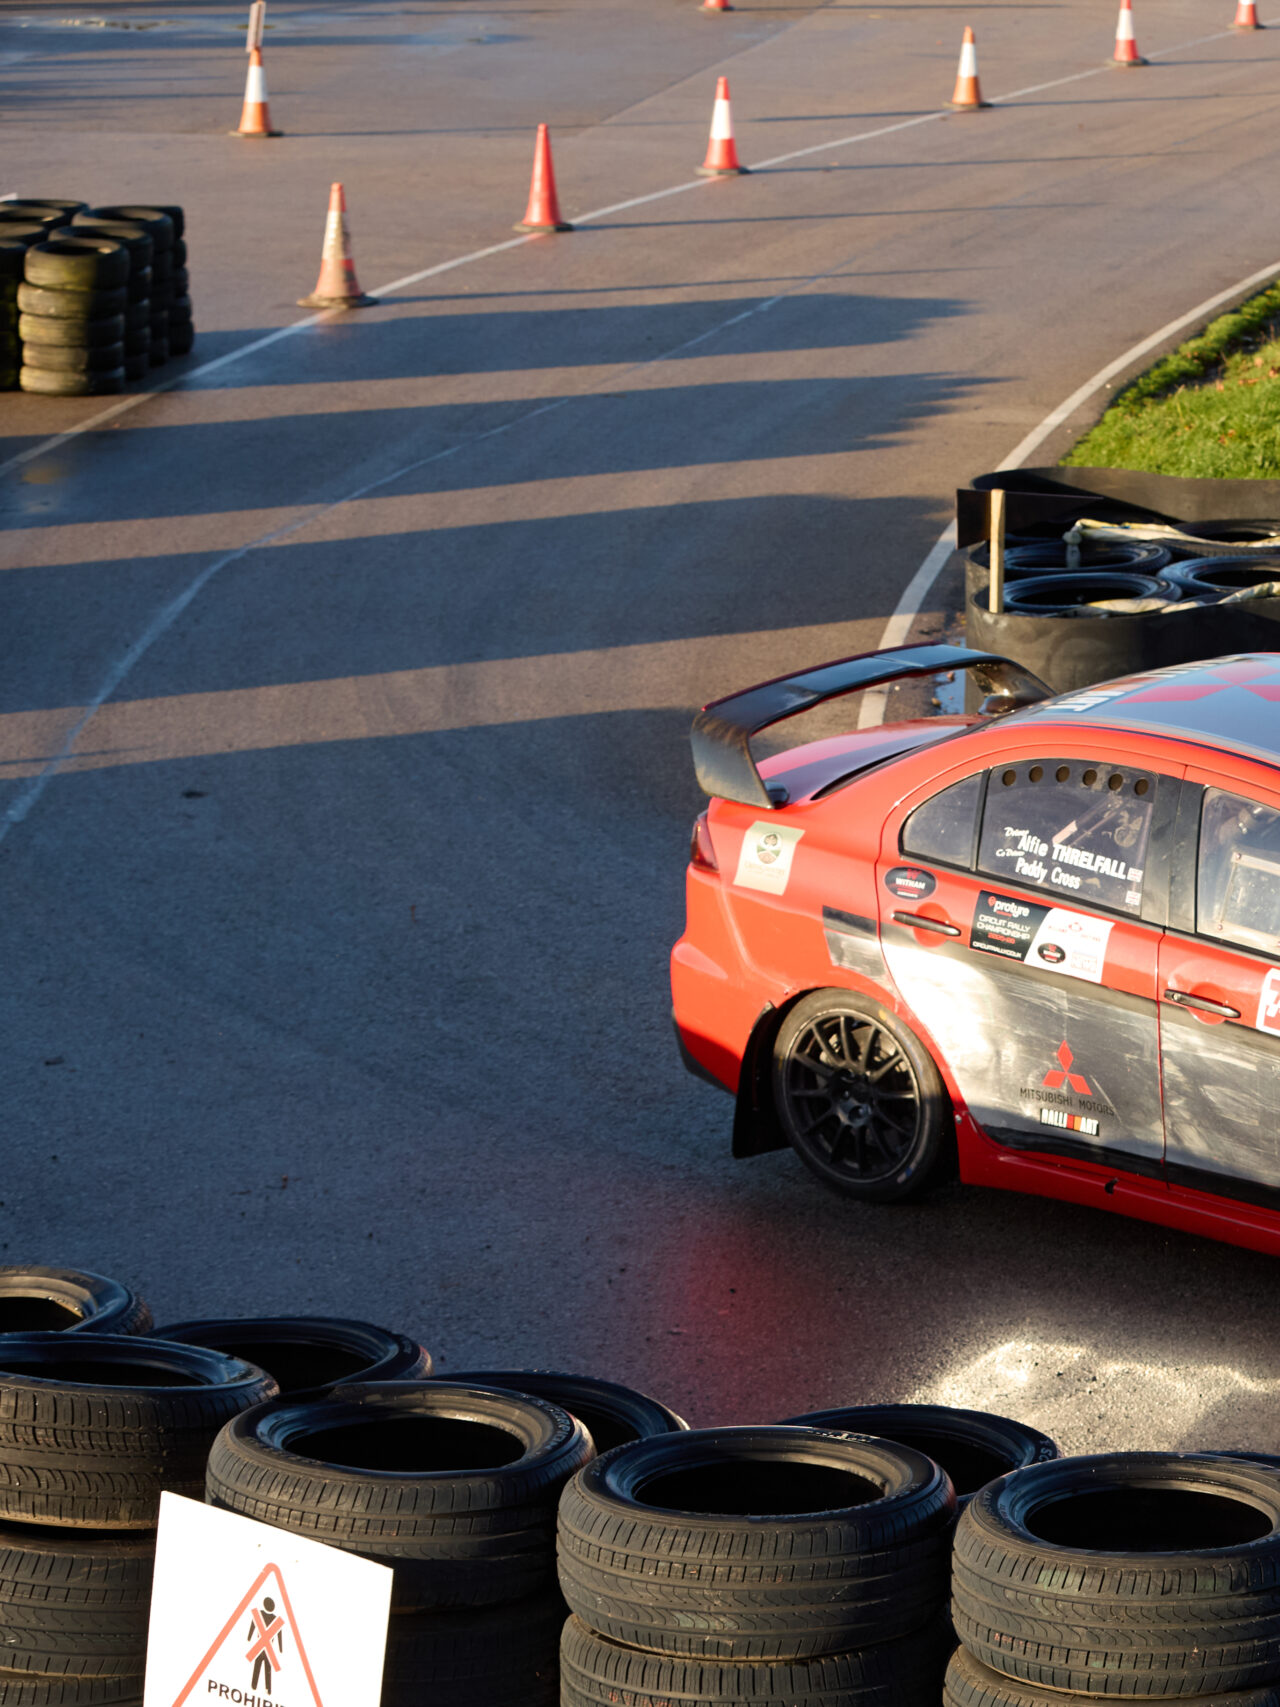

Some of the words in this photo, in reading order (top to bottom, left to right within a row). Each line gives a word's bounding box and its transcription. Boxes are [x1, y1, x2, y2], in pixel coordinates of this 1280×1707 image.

[1017, 834, 1048, 857] Alfie
[1052, 843, 1126, 880] THRELFALL
[1015, 857, 1047, 884] Paddy
[1051, 868, 1081, 889] Cross
[993, 900, 1030, 918] protyre
[1020, 1087, 1073, 1106] MITSUBISHI
[1078, 1099, 1115, 1116] MOTORS
